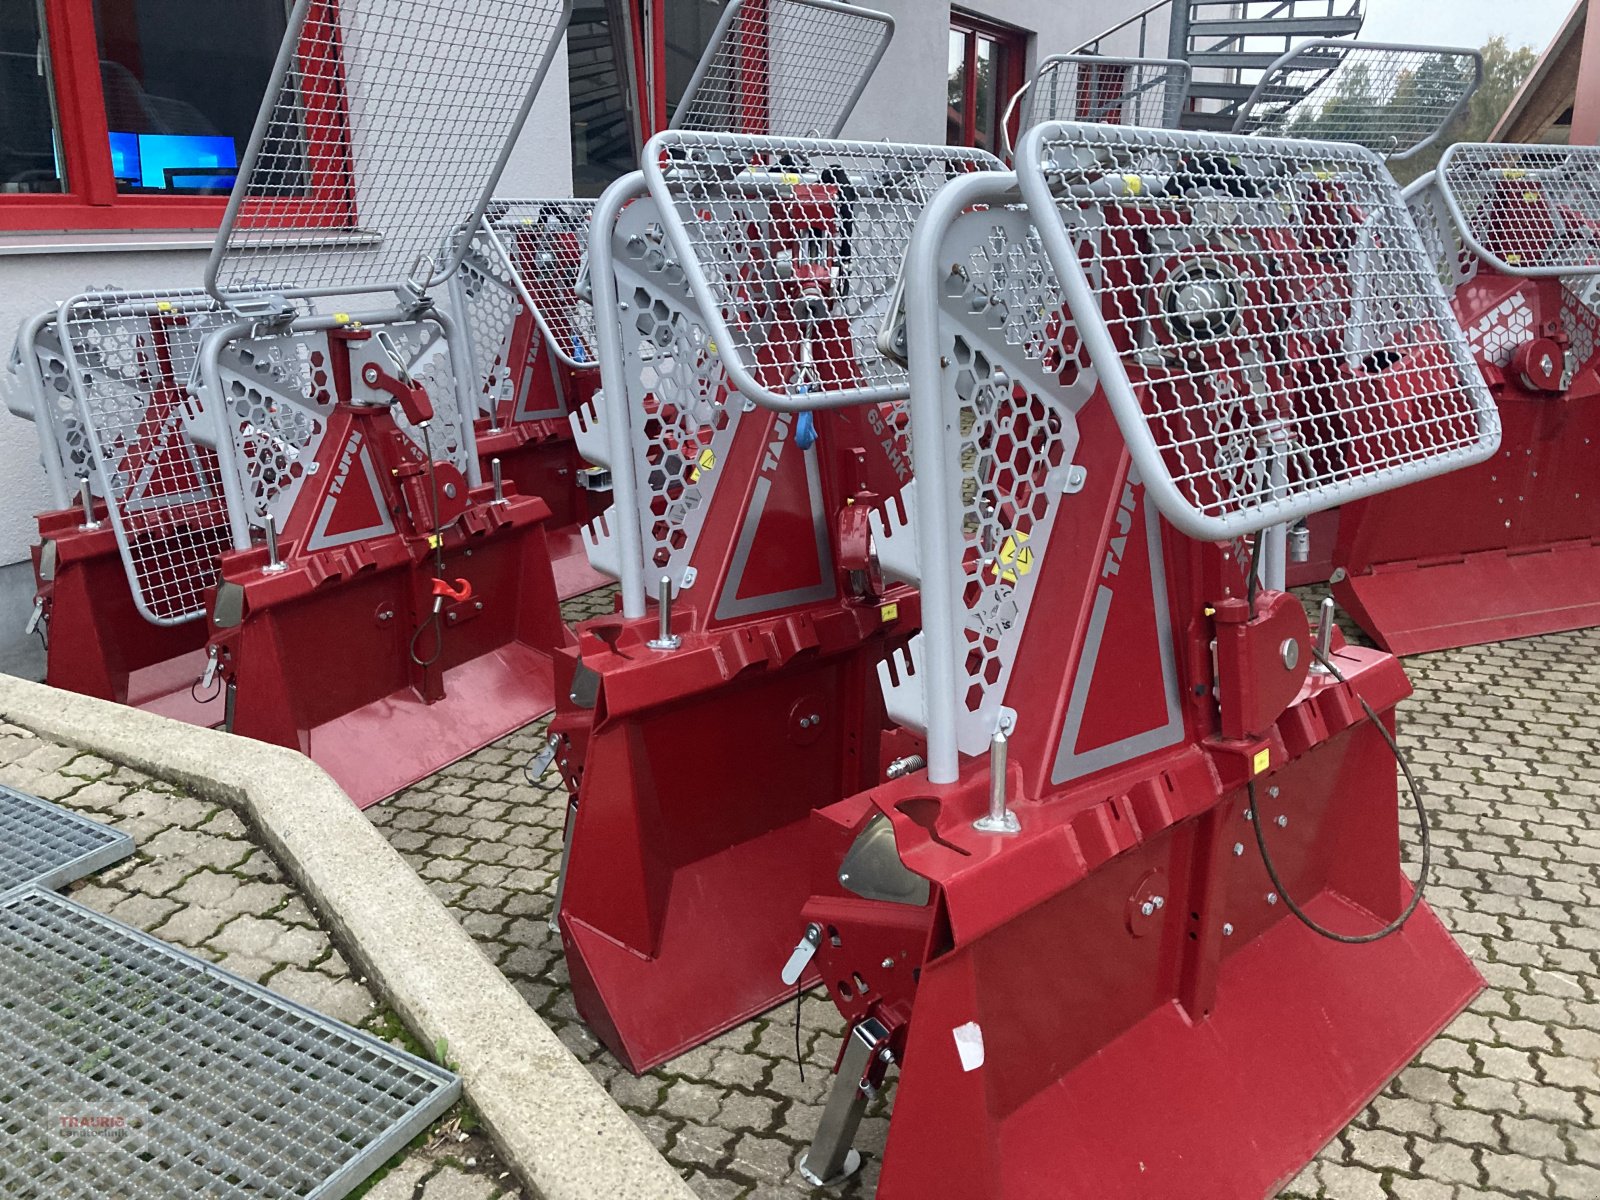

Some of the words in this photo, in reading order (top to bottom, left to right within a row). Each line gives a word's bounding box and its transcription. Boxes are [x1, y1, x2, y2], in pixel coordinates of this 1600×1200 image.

[328, 429, 363, 495] TAJFUN
[867, 408, 885, 436] 65
[881, 438, 909, 482] AHK
